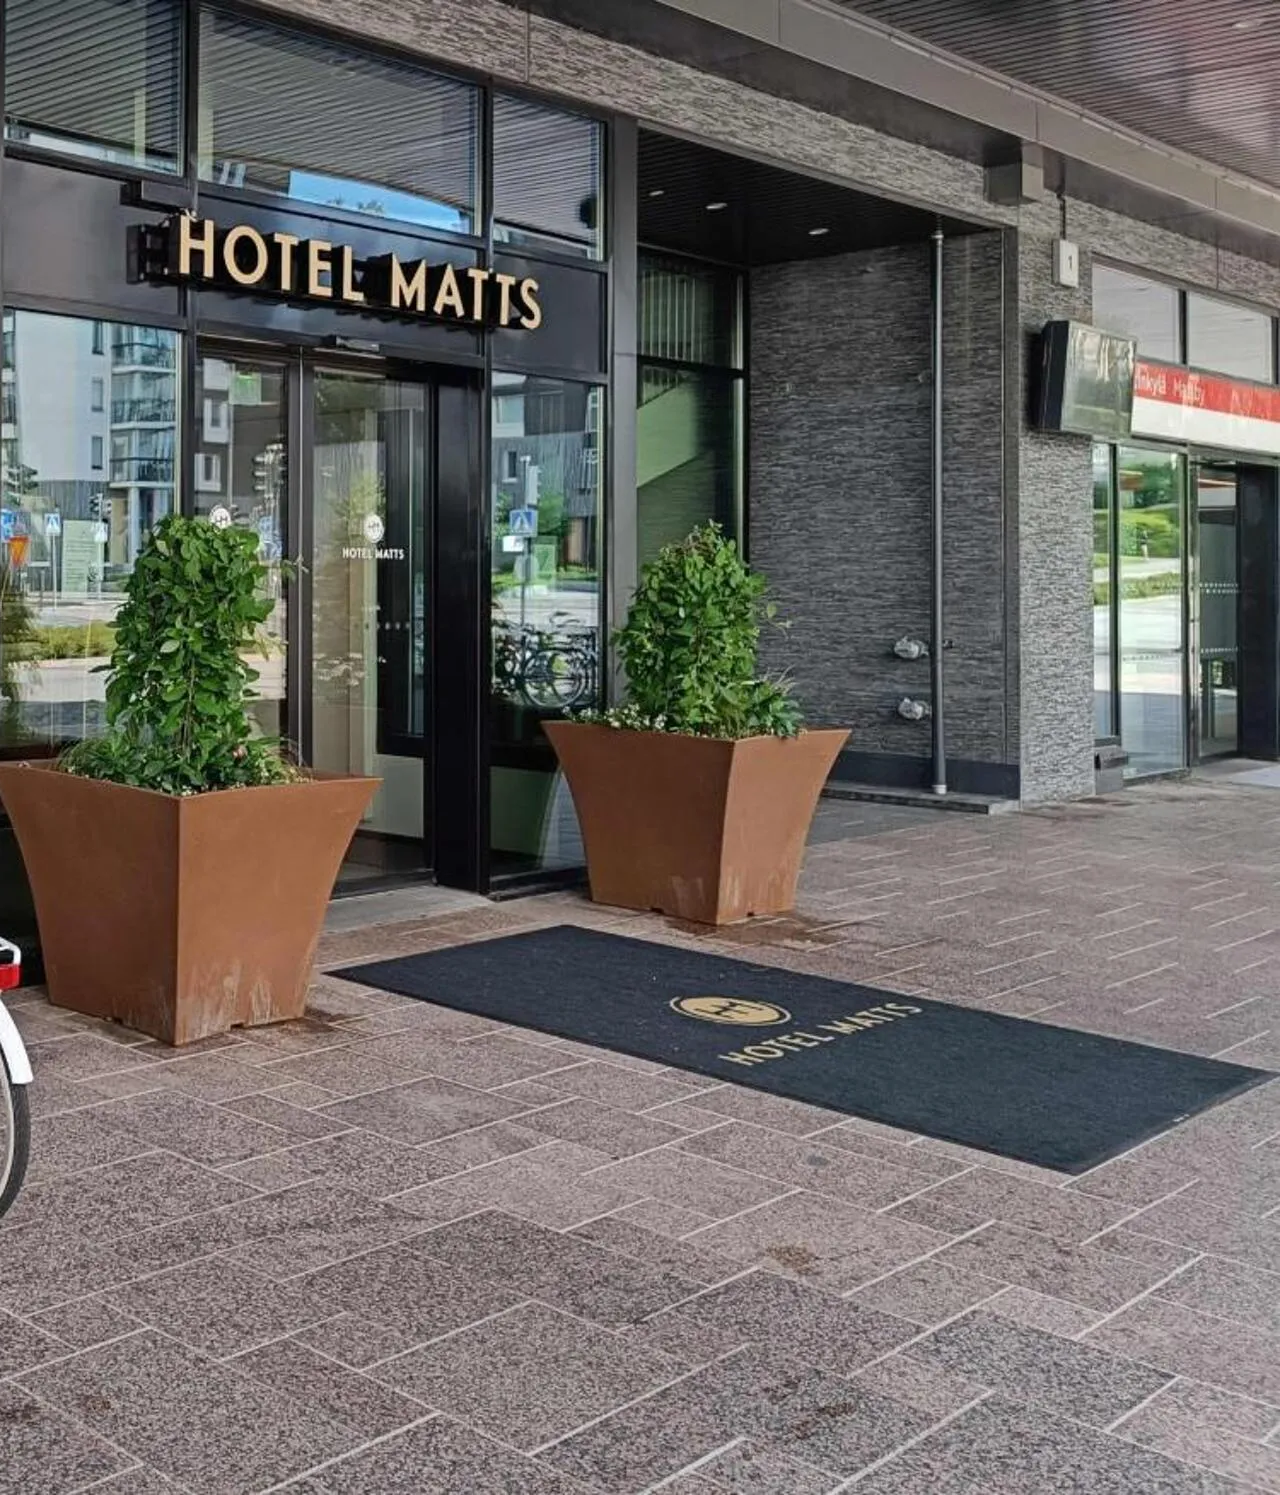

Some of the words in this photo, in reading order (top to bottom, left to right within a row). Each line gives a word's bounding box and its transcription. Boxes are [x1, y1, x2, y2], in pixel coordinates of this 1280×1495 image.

[179, 215, 365, 302] HOTEL
[391, 253, 542, 330] MATTS
[342, 547, 373, 560] HOTEL
[375, 548, 404, 560] MATTS
[718, 1031, 835, 1066] HOTEL
[817, 1002, 923, 1035] MATTS
